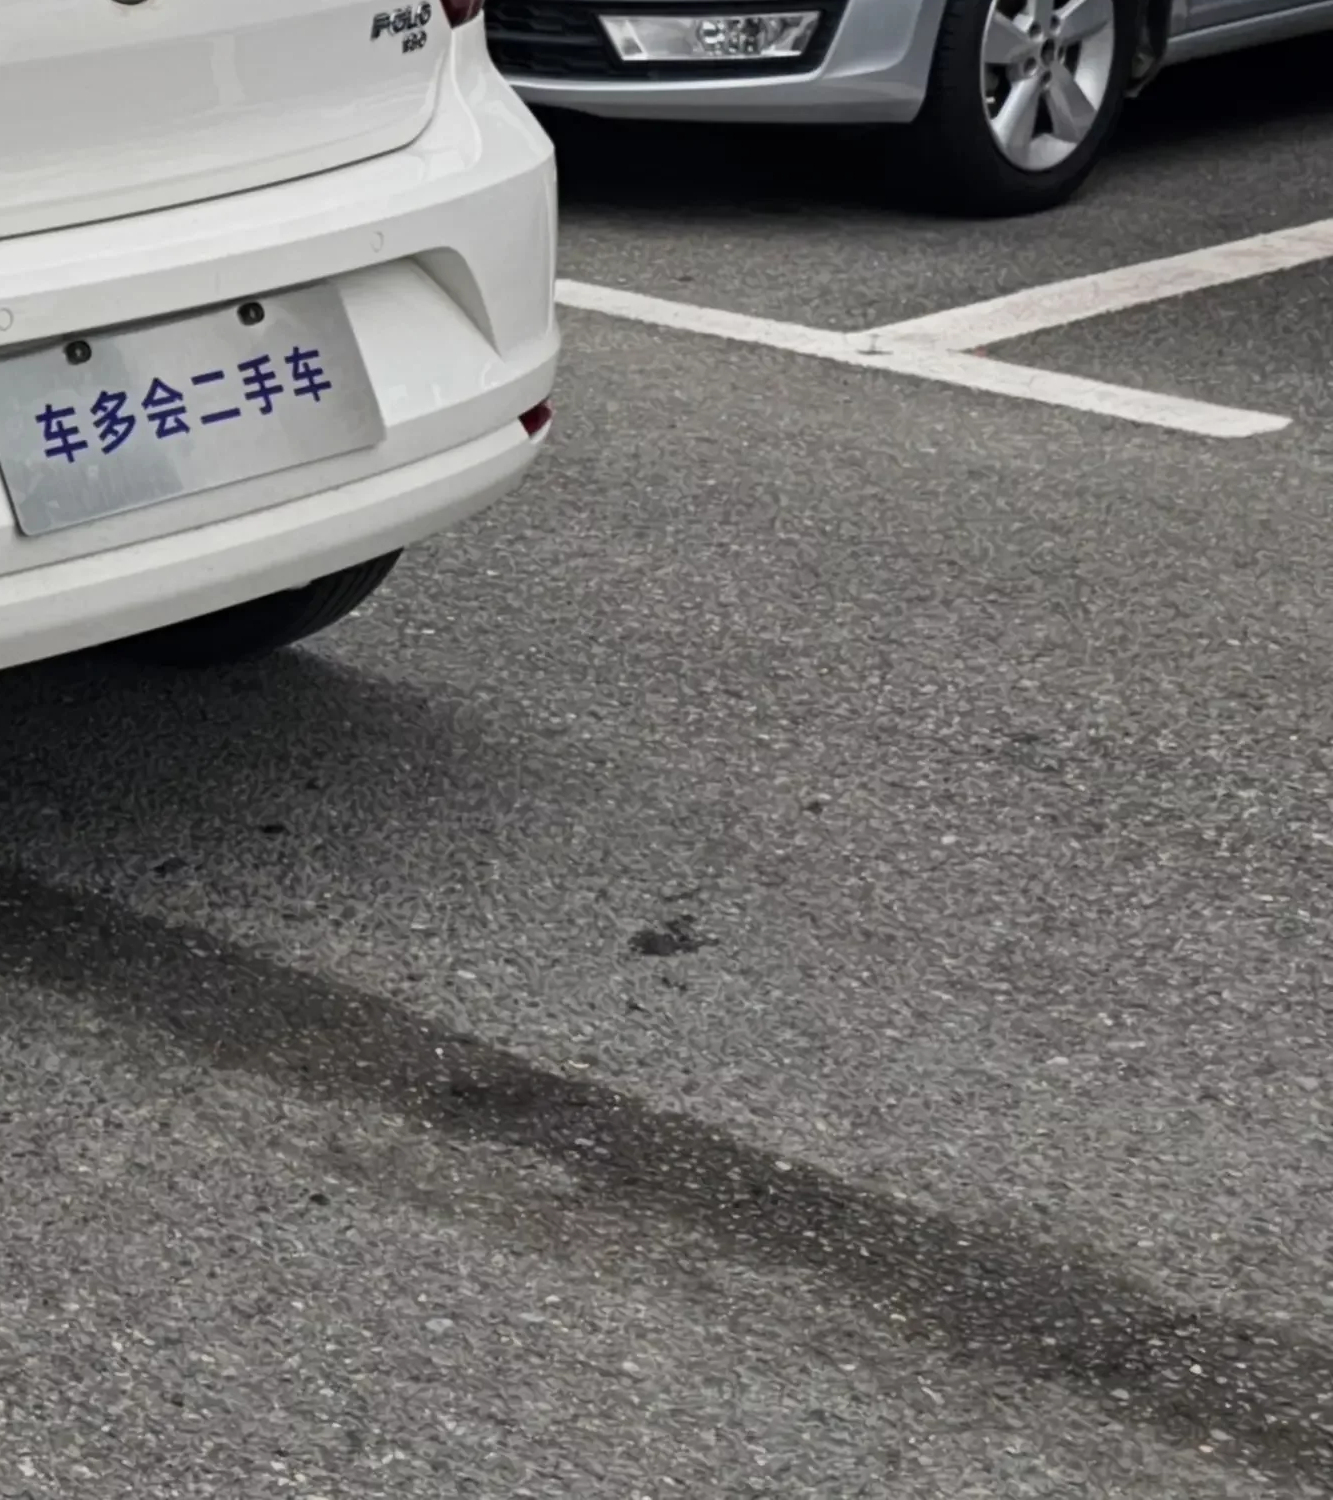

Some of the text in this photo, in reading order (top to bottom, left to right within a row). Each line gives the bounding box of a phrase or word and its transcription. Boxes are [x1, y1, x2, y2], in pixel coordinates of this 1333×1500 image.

[371, 1, 432, 40] POLO
[35, 346, 333, 464] 车多会二手车
